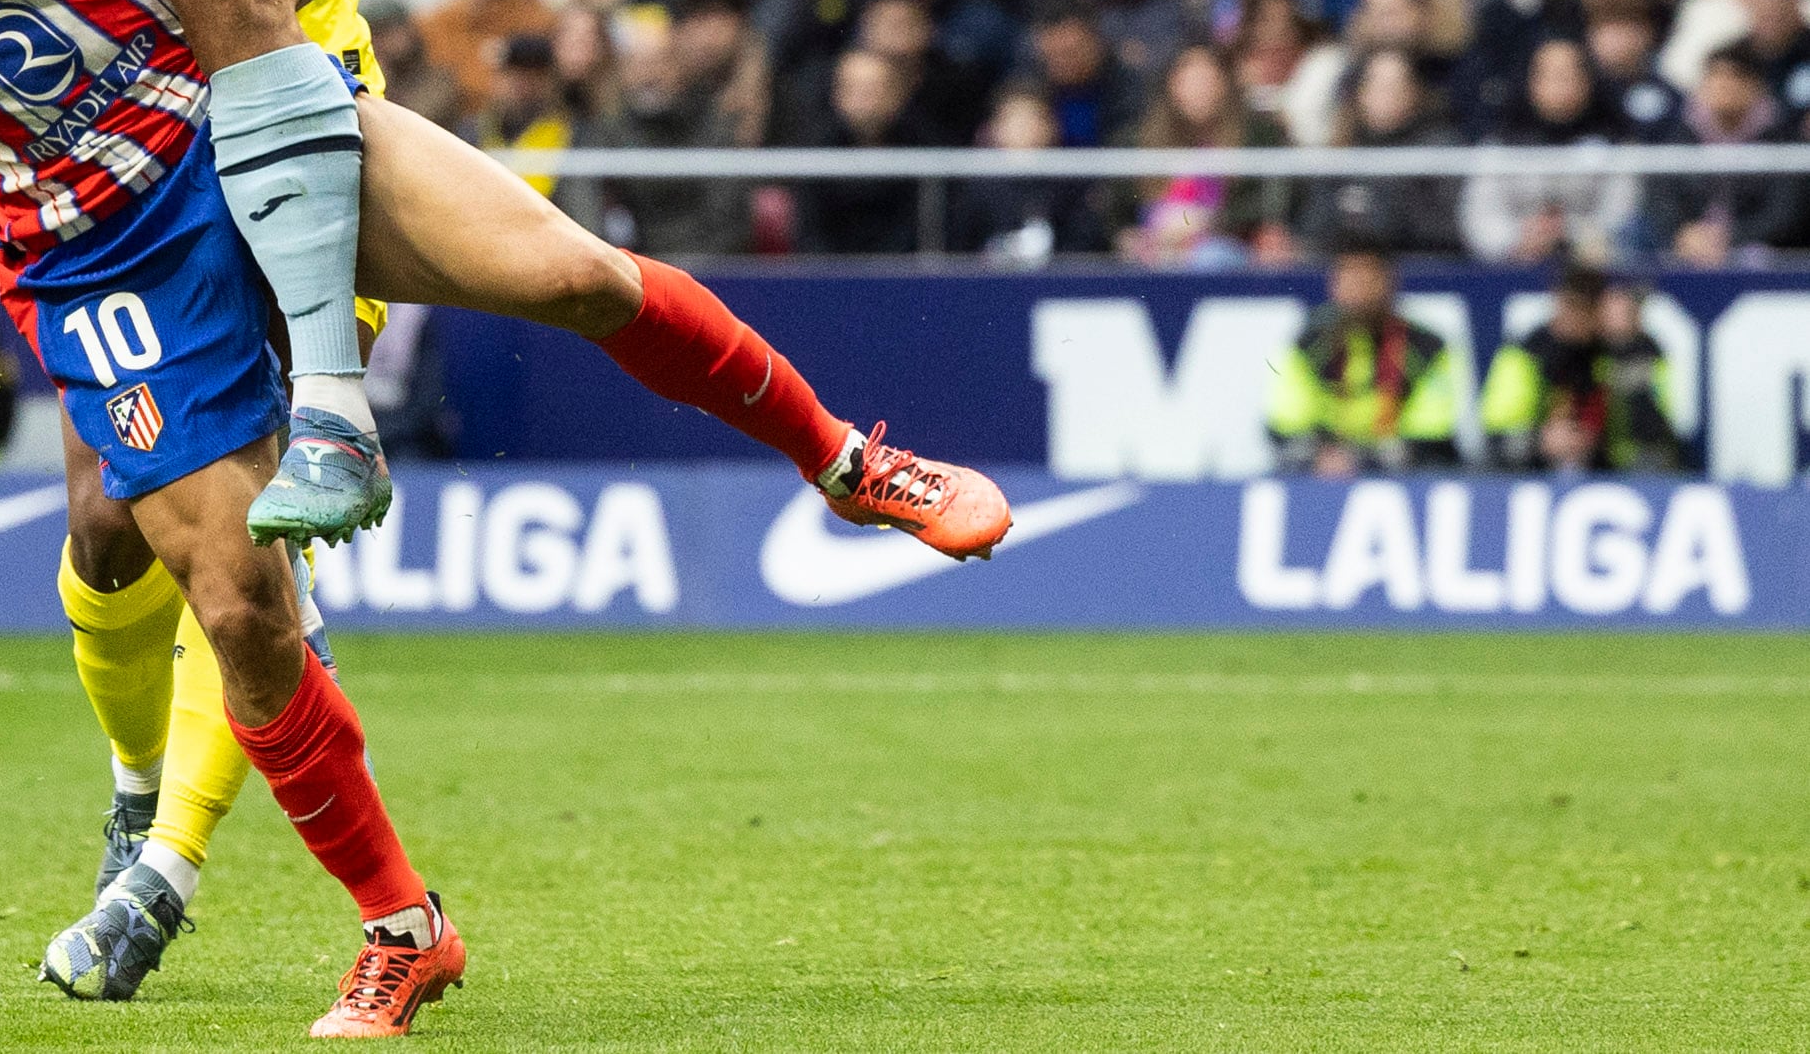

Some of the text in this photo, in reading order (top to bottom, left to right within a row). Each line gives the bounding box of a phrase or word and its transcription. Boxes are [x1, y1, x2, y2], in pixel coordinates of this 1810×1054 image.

[27, 34, 154, 162] RIYADH AIR
[63, 291, 162, 388] 10
[1237, 479, 1751, 613] LALIGA
